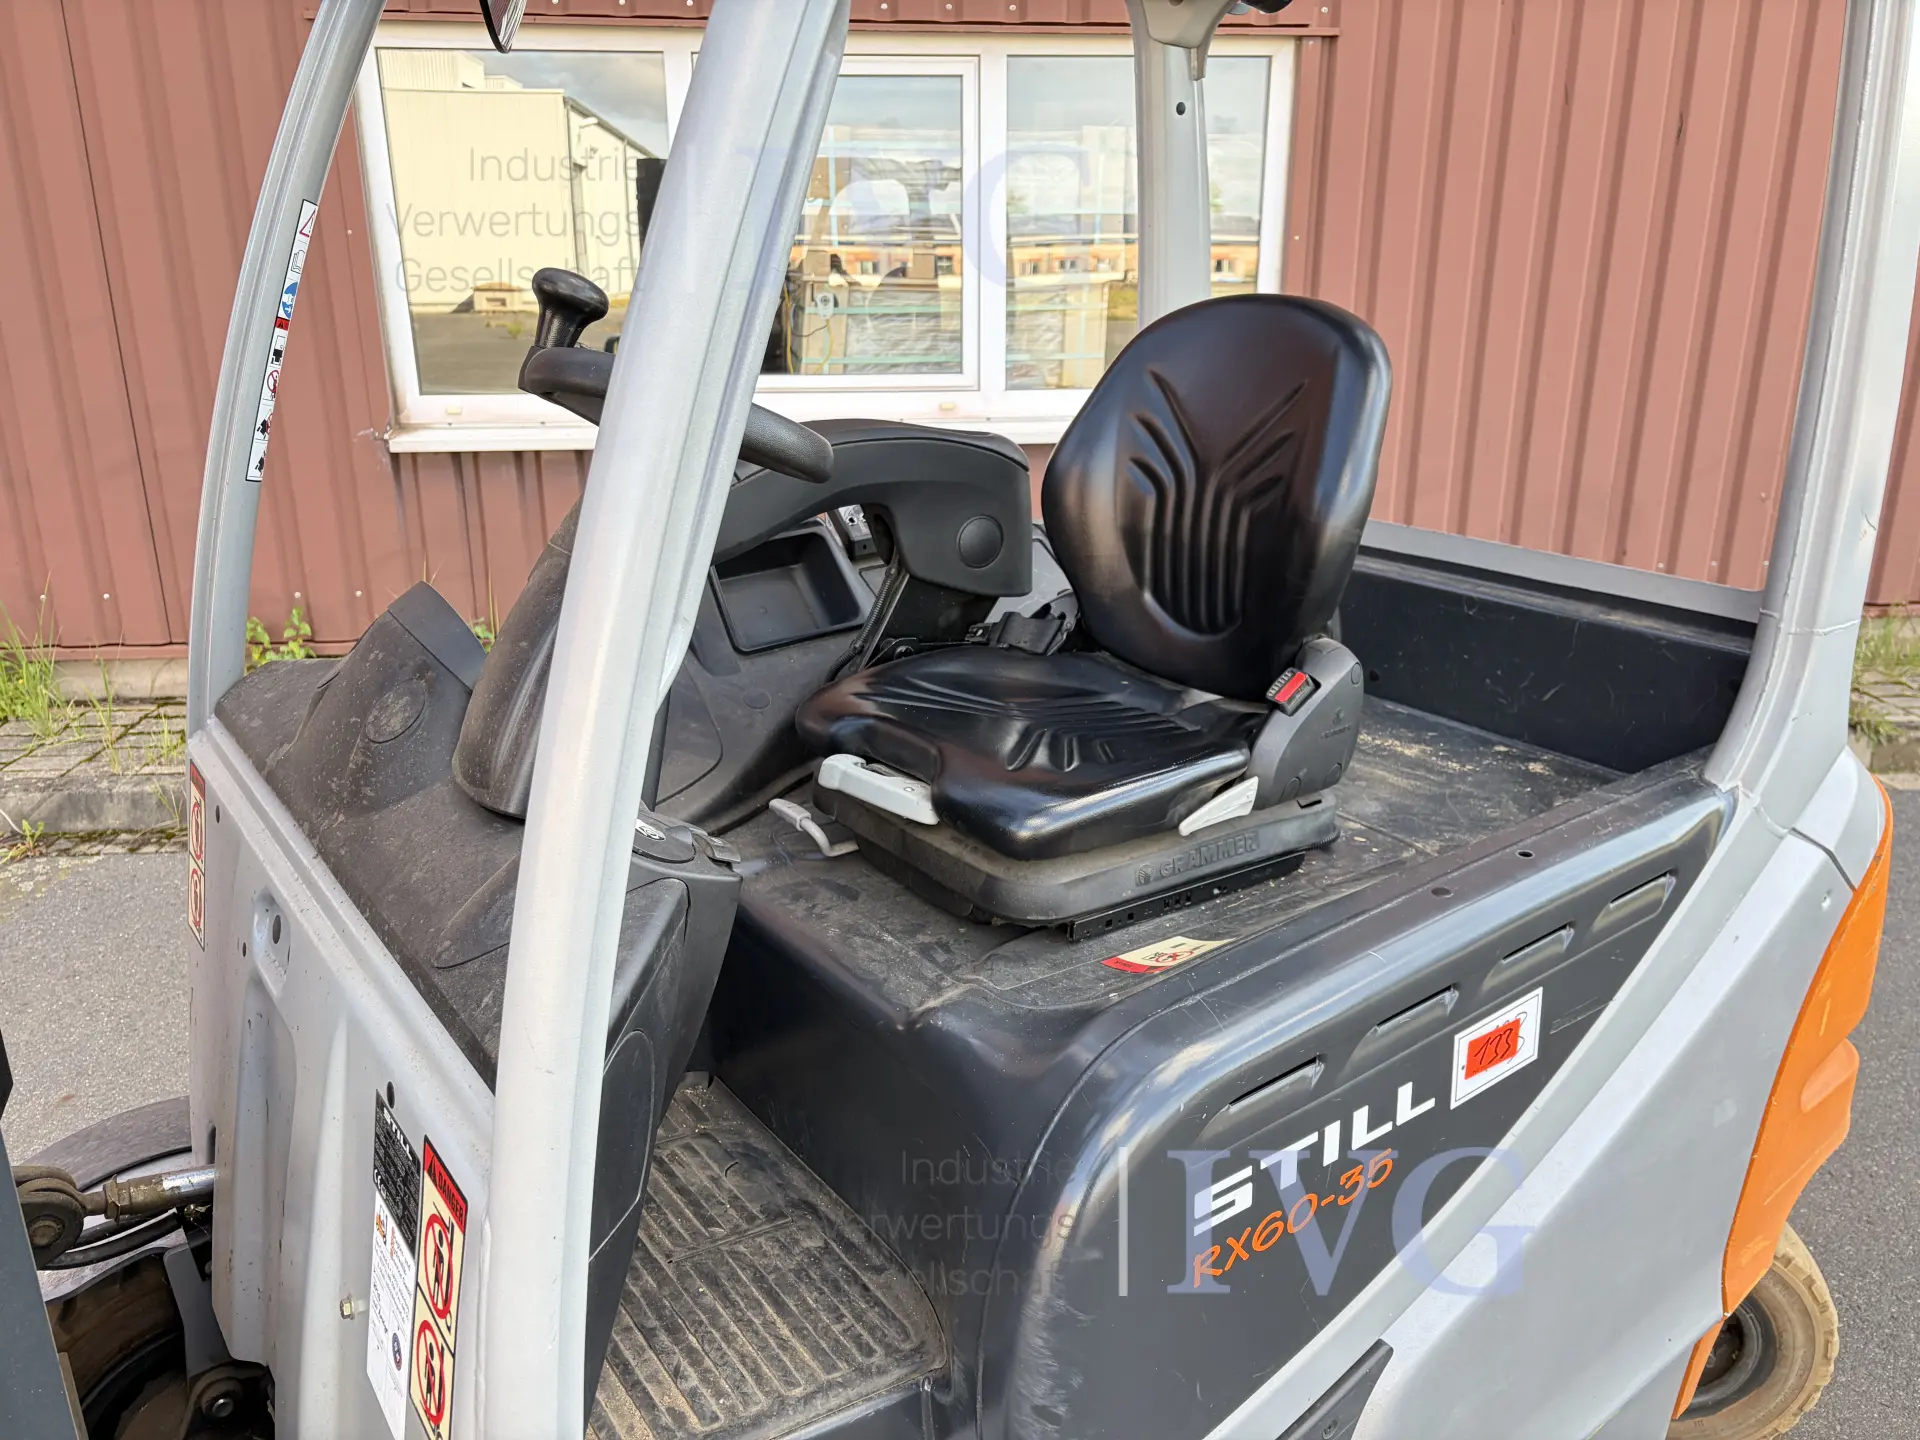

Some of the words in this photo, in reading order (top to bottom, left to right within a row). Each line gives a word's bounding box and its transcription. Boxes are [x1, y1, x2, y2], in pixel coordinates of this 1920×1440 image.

[1160, 831, 1260, 877] GRAMMER
[438, 1171, 465, 1225] DANGER
[1193, 1081, 1435, 1236] STILL
[1193, 1148, 1393, 1288] RX60-35
